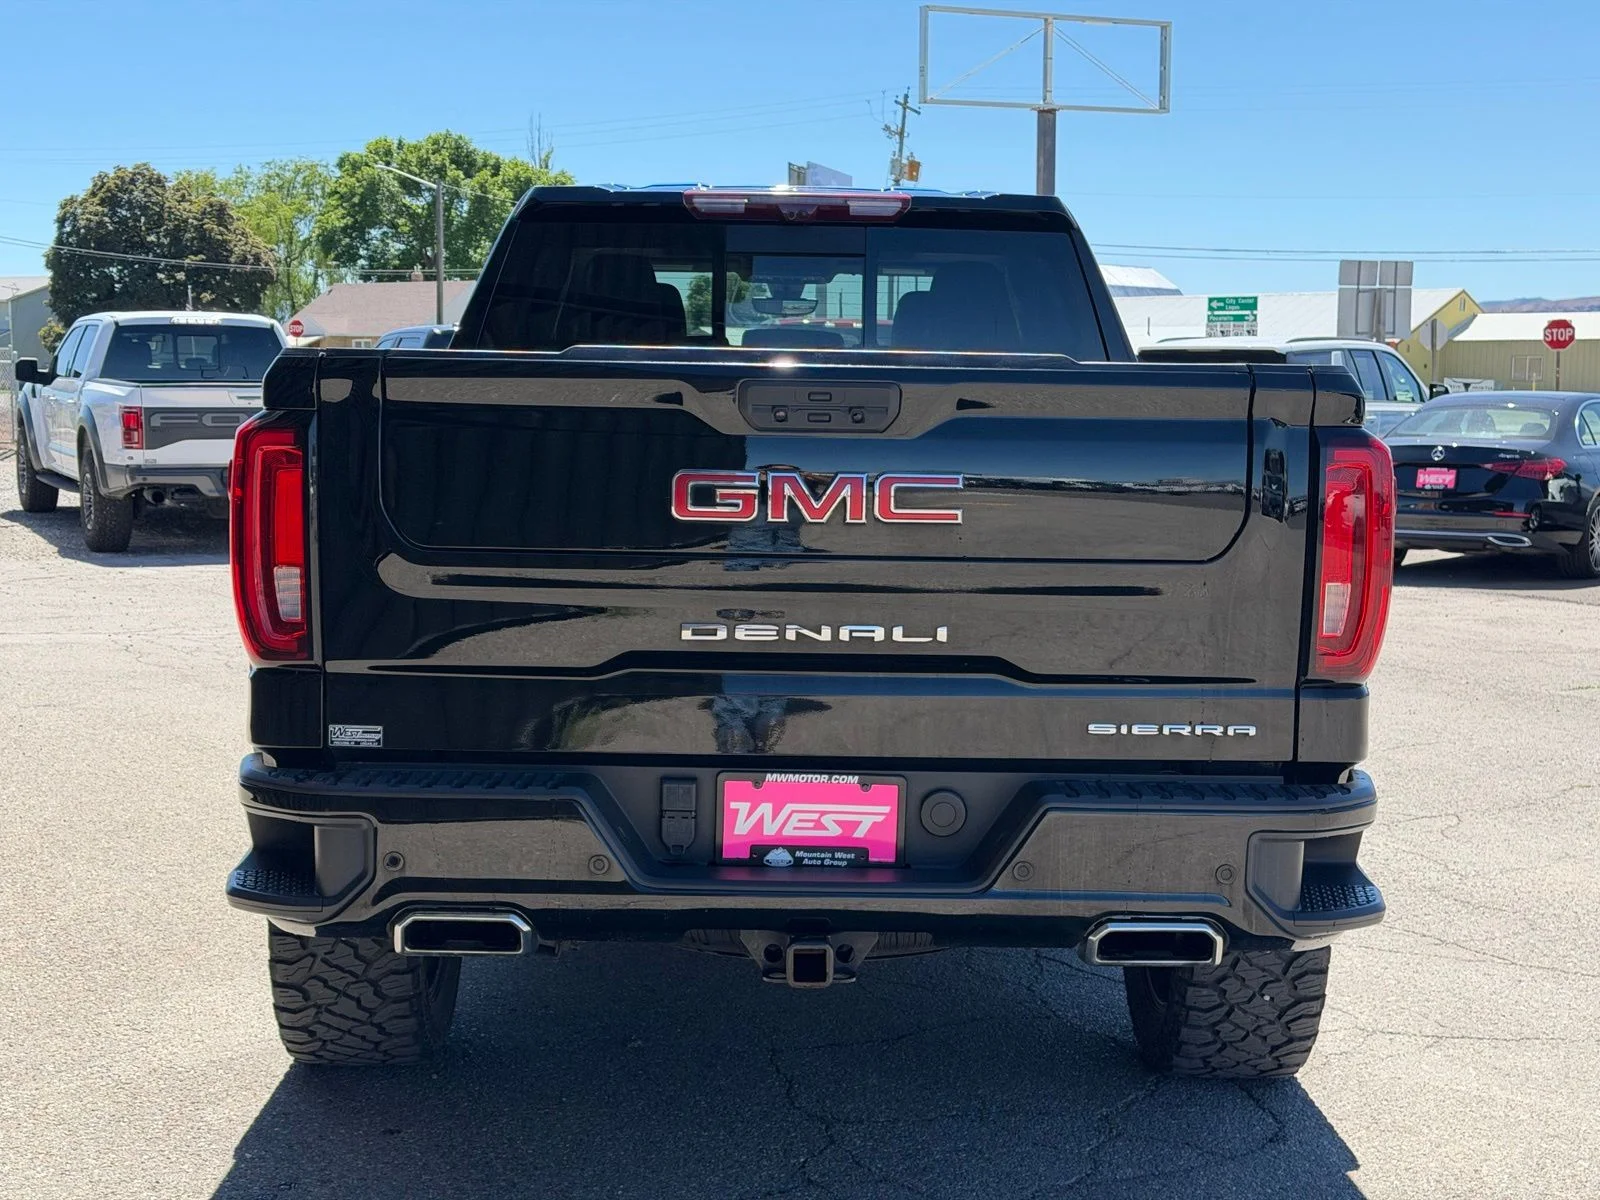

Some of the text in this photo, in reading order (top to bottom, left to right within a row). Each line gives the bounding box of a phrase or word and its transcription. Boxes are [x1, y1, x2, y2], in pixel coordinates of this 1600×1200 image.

[289, 325, 303, 333] STOP
[1545, 328, 1573, 341] STOP
[149, 412, 248, 427] FO
[1419, 474, 1454, 484] WEST
[671, 469, 963, 525] GMC
[681, 623, 947, 643] DENALI
[1088, 723, 1257, 737] SIERRA
[765, 773, 859, 785] MWMOTOR.COM
[729, 802, 891, 838] WEST
[795, 850, 856, 860] Mountain West
[823, 859, 848, 867] Group
